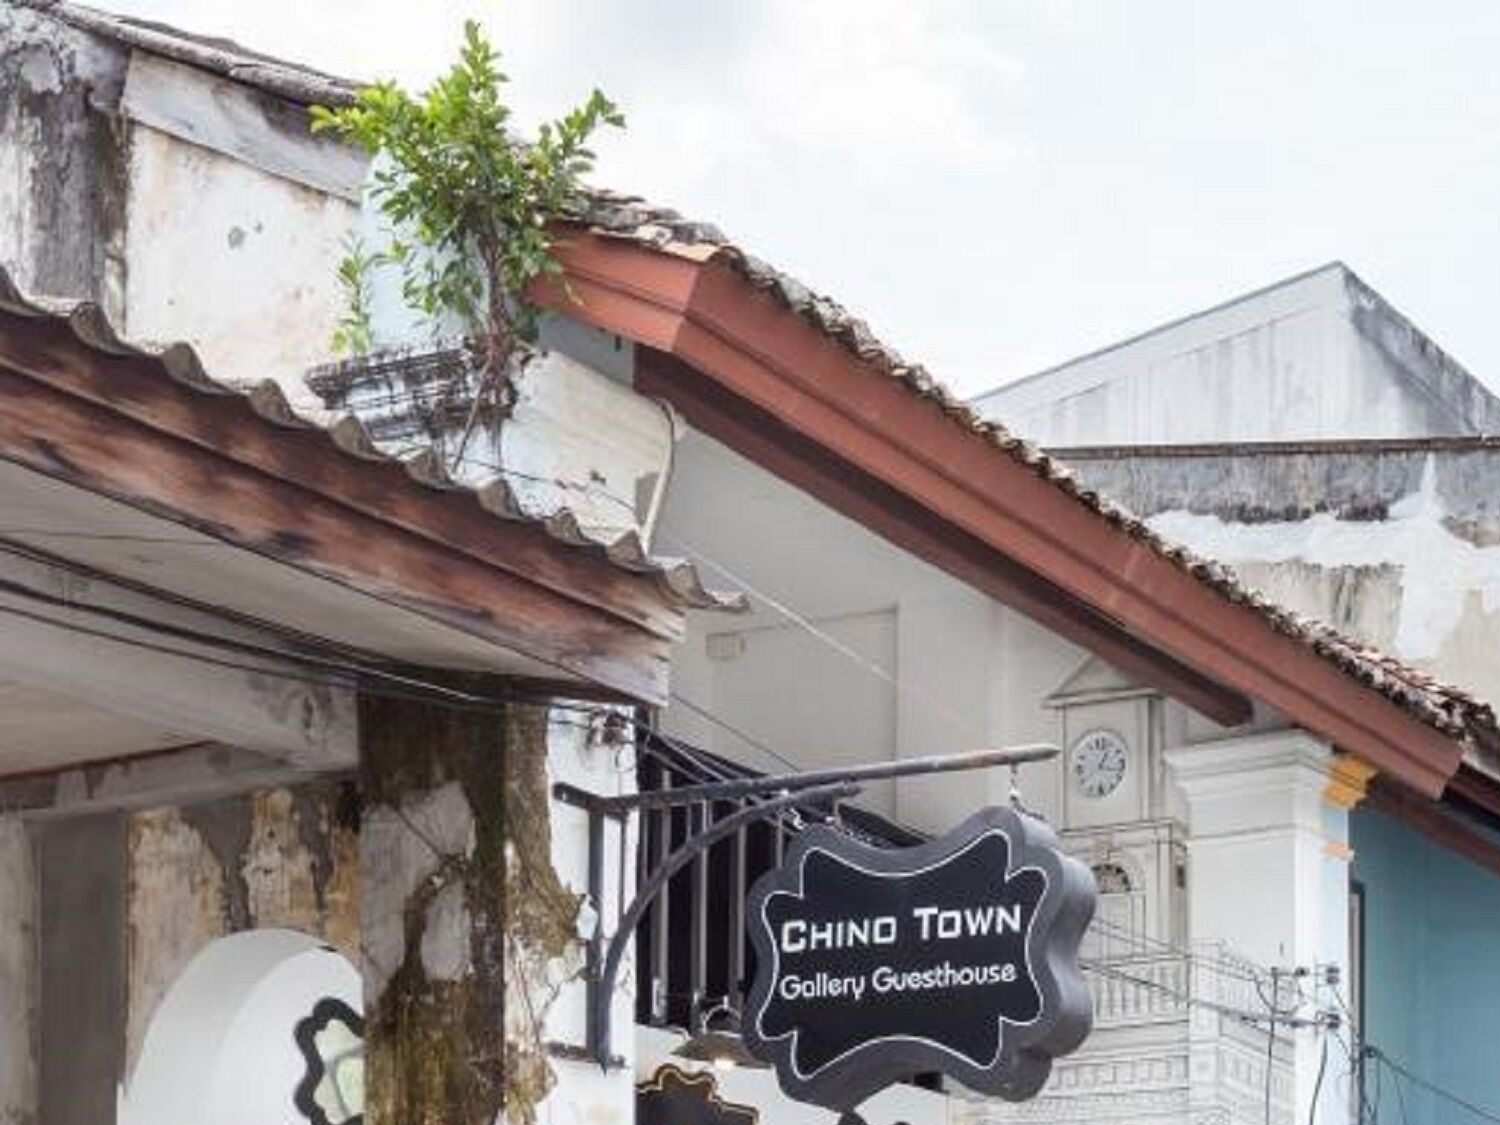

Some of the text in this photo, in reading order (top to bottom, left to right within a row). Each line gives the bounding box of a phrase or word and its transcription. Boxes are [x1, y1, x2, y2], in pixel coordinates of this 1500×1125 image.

[781, 904, 1022, 953] CHINO TOWN
[780, 961, 1017, 1000] Gallery Guesthouse
